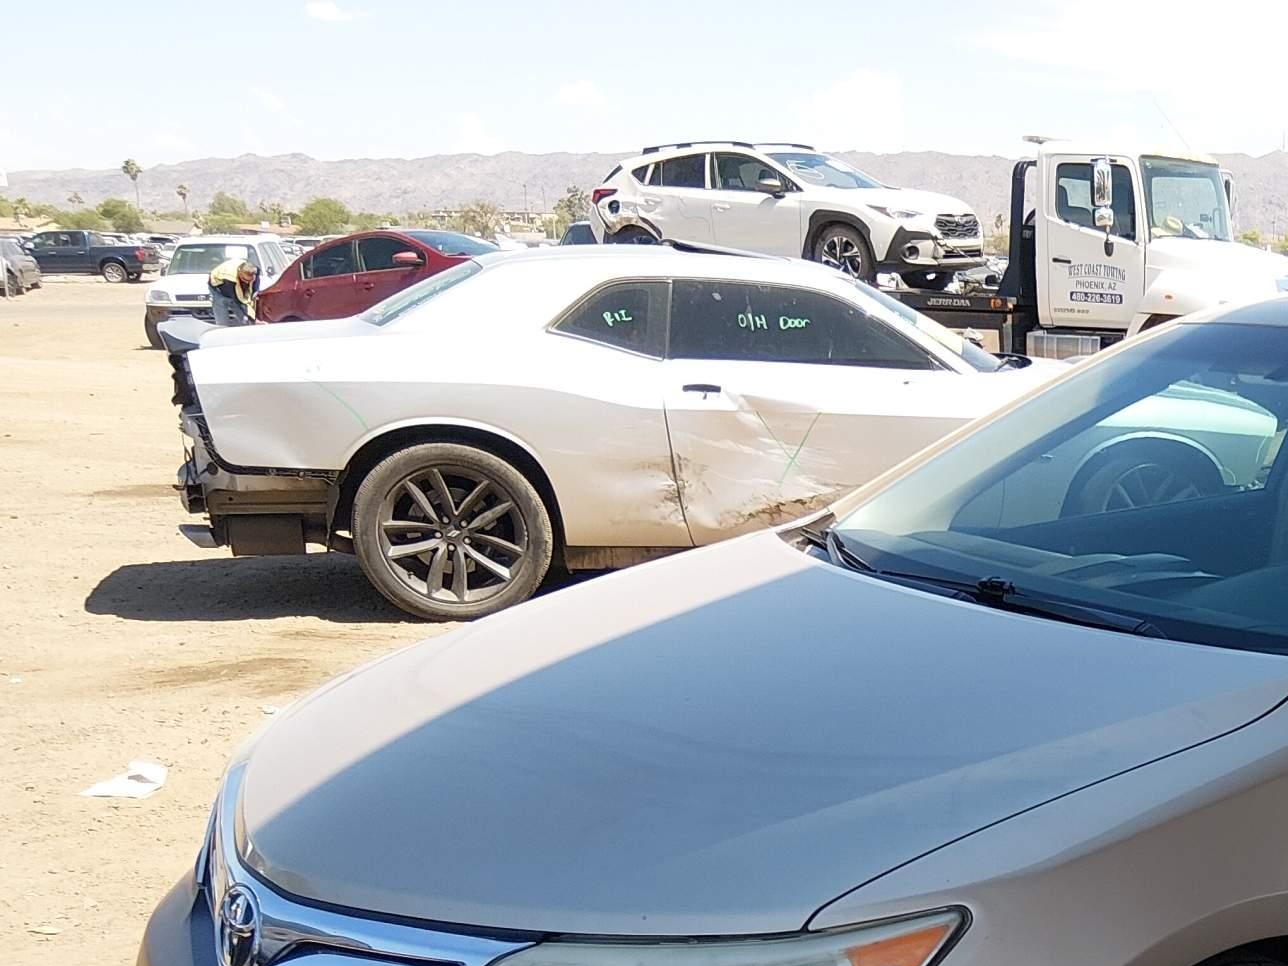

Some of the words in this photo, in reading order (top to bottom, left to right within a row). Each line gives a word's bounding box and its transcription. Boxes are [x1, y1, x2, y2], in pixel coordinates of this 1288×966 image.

[1068, 264, 1083, 276] WEST
[1084, 264, 1102, 277] COAST
[1103, 265, 1126, 281] TOWING
[1108, 282, 1117, 291] AZ
